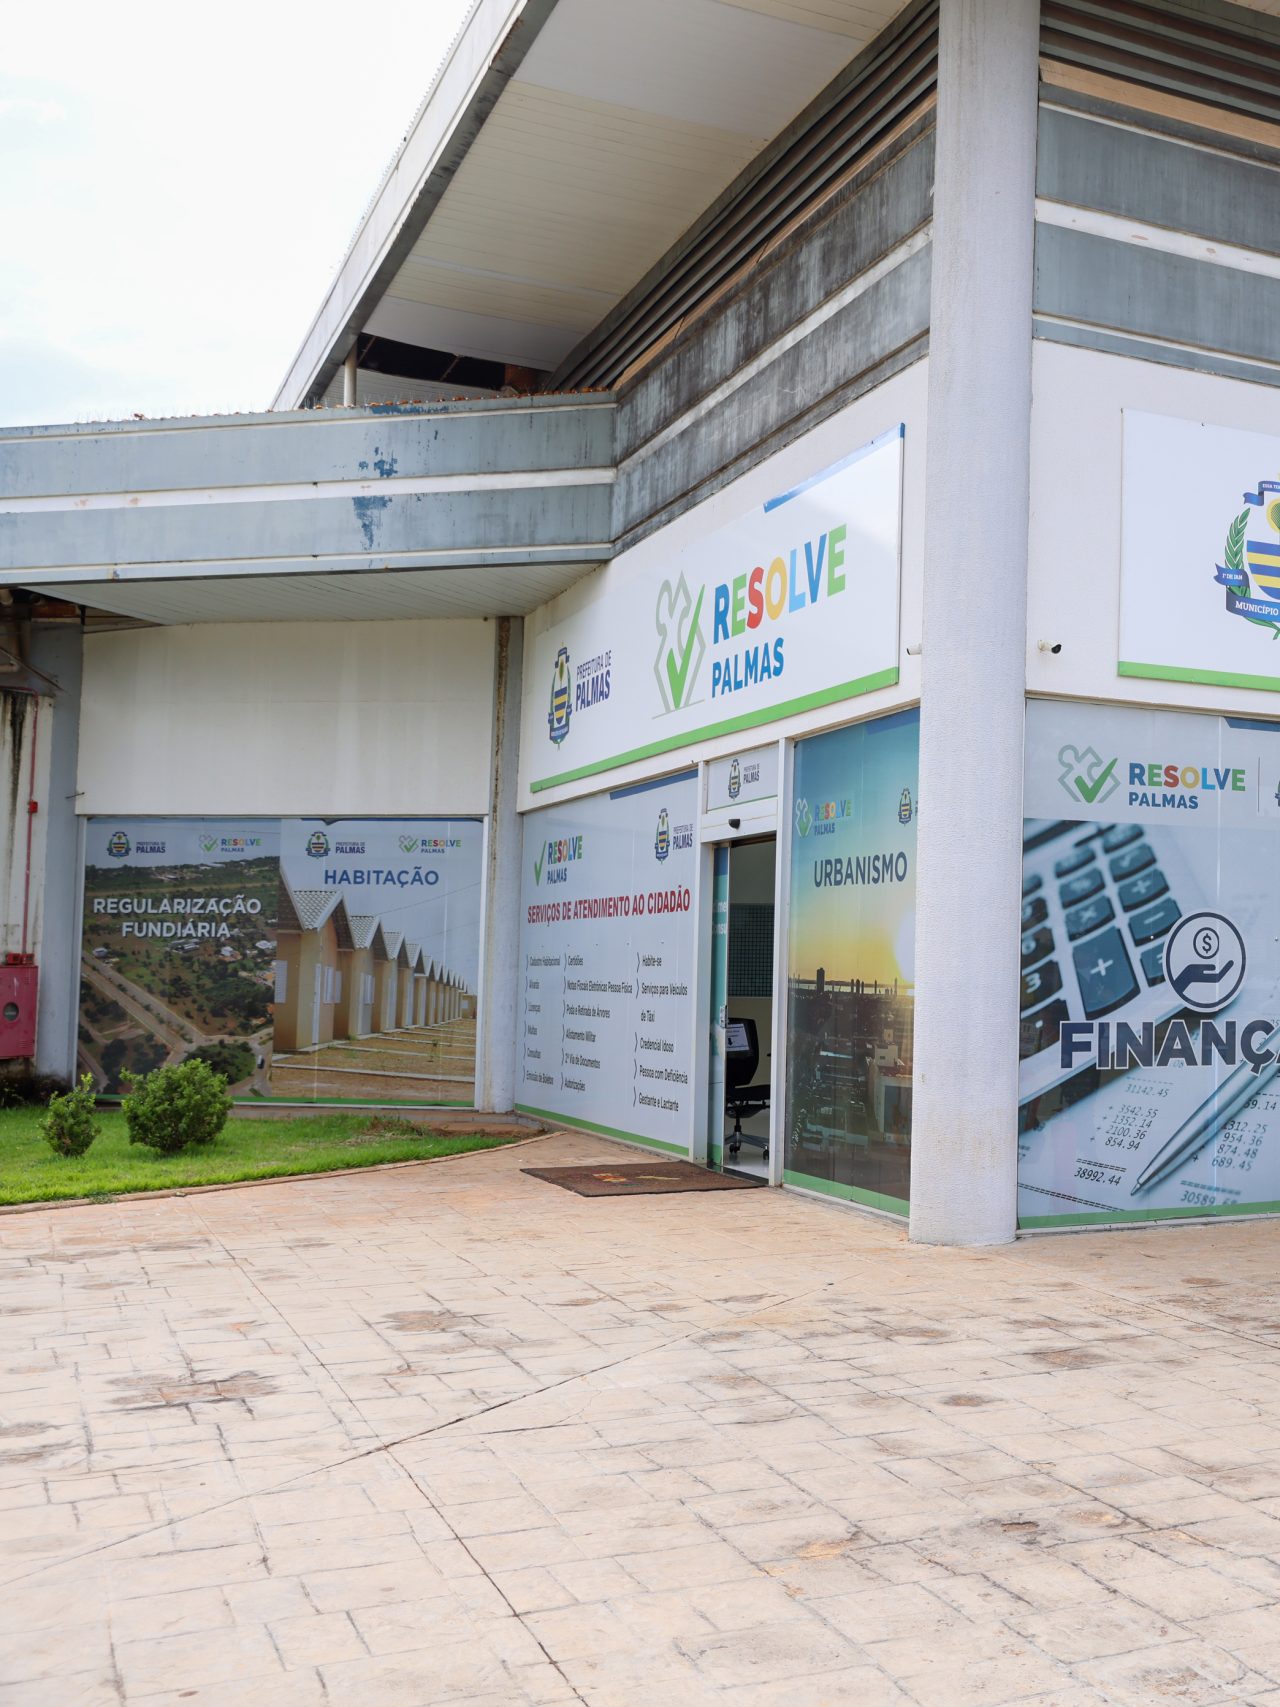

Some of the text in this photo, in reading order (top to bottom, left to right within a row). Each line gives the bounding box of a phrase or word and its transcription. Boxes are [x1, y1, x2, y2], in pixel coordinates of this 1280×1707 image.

[713, 524, 847, 645] RESOLVE
[1235, 600, 1279, 616] MUNICÍPIO
[577, 650, 611, 681] PREFEITURA DE
[712, 637, 784, 699] PALMAS
[576, 669, 610, 712] PALMAS
[743, 771, 760, 785] PALMAS
[1129, 762, 1246, 792] RESOLVE
[1129, 791, 1198, 810] PALMAS
[814, 800, 852, 822] RESOLVE
[814, 822, 835, 836] PALMAS
[136, 846, 166, 854] PALMAS
[221, 838, 261, 847] RESOLVE
[421, 839, 461, 848] RESOLVE
[548, 835, 583, 865] RESOLVE
[672, 833, 693, 850] PALMAS
[324, 866, 439, 888] HABITAÇÃO
[547, 867, 567, 885] PALMAS
[814, 851, 907, 888] URBANISMO
[93, 894, 262, 917] REGULARIZAÇÃO
[528, 901, 560, 927] SERVIÇOS
[562, 901, 571, 920] DE
[573, 896, 630, 920] ATENDIMENTO
[632, 893, 644, 916] AO
[647, 885, 690, 915] CIDADÃO
[122, 918, 230, 938] FUNDIÁRIA
[658, 985, 669, 997] para
[640, 1010, 646, 1021] de
[654, 1069, 664, 1080] com
[1118, 1104, 1159, 1119] 3542.55
[1112, 1114, 1153, 1129] 1352.14
[1105, 1125, 1147, 1140] 2100.36
[1105, 1136, 1141, 1151] 854.94
[1073, 1167, 1122, 1187] 38992.44
